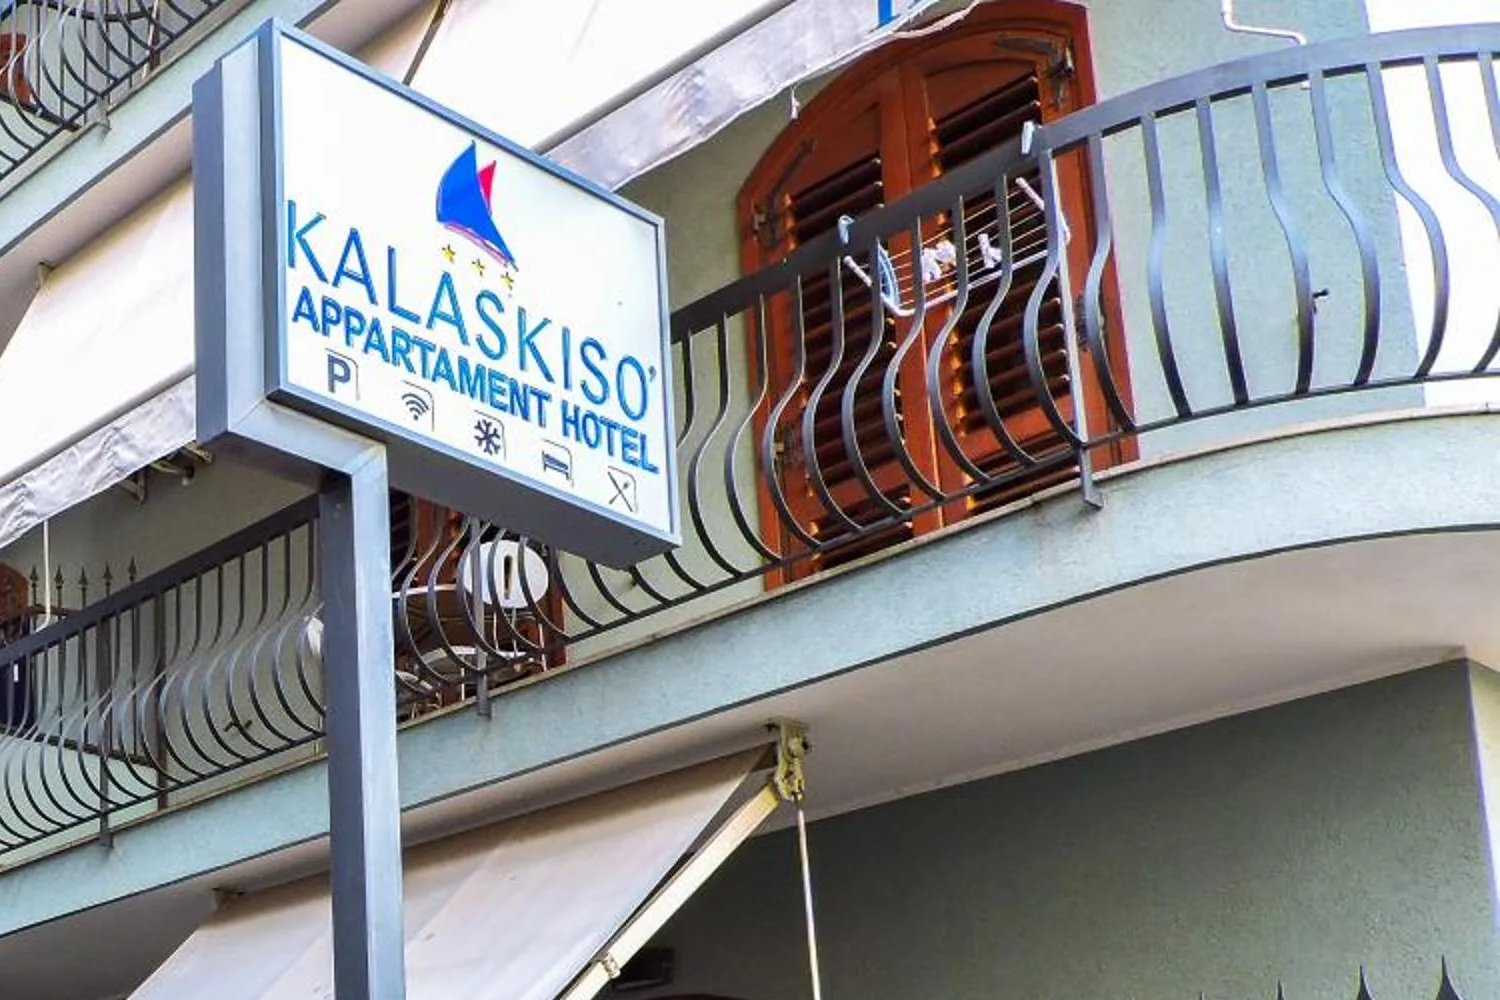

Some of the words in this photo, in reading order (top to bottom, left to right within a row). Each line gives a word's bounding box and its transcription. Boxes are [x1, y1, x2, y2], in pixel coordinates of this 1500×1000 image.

[292, 286, 552, 428] APPARTAMENT
[561, 399, 660, 475] HOTEL
[327, 353, 351, 394] P
